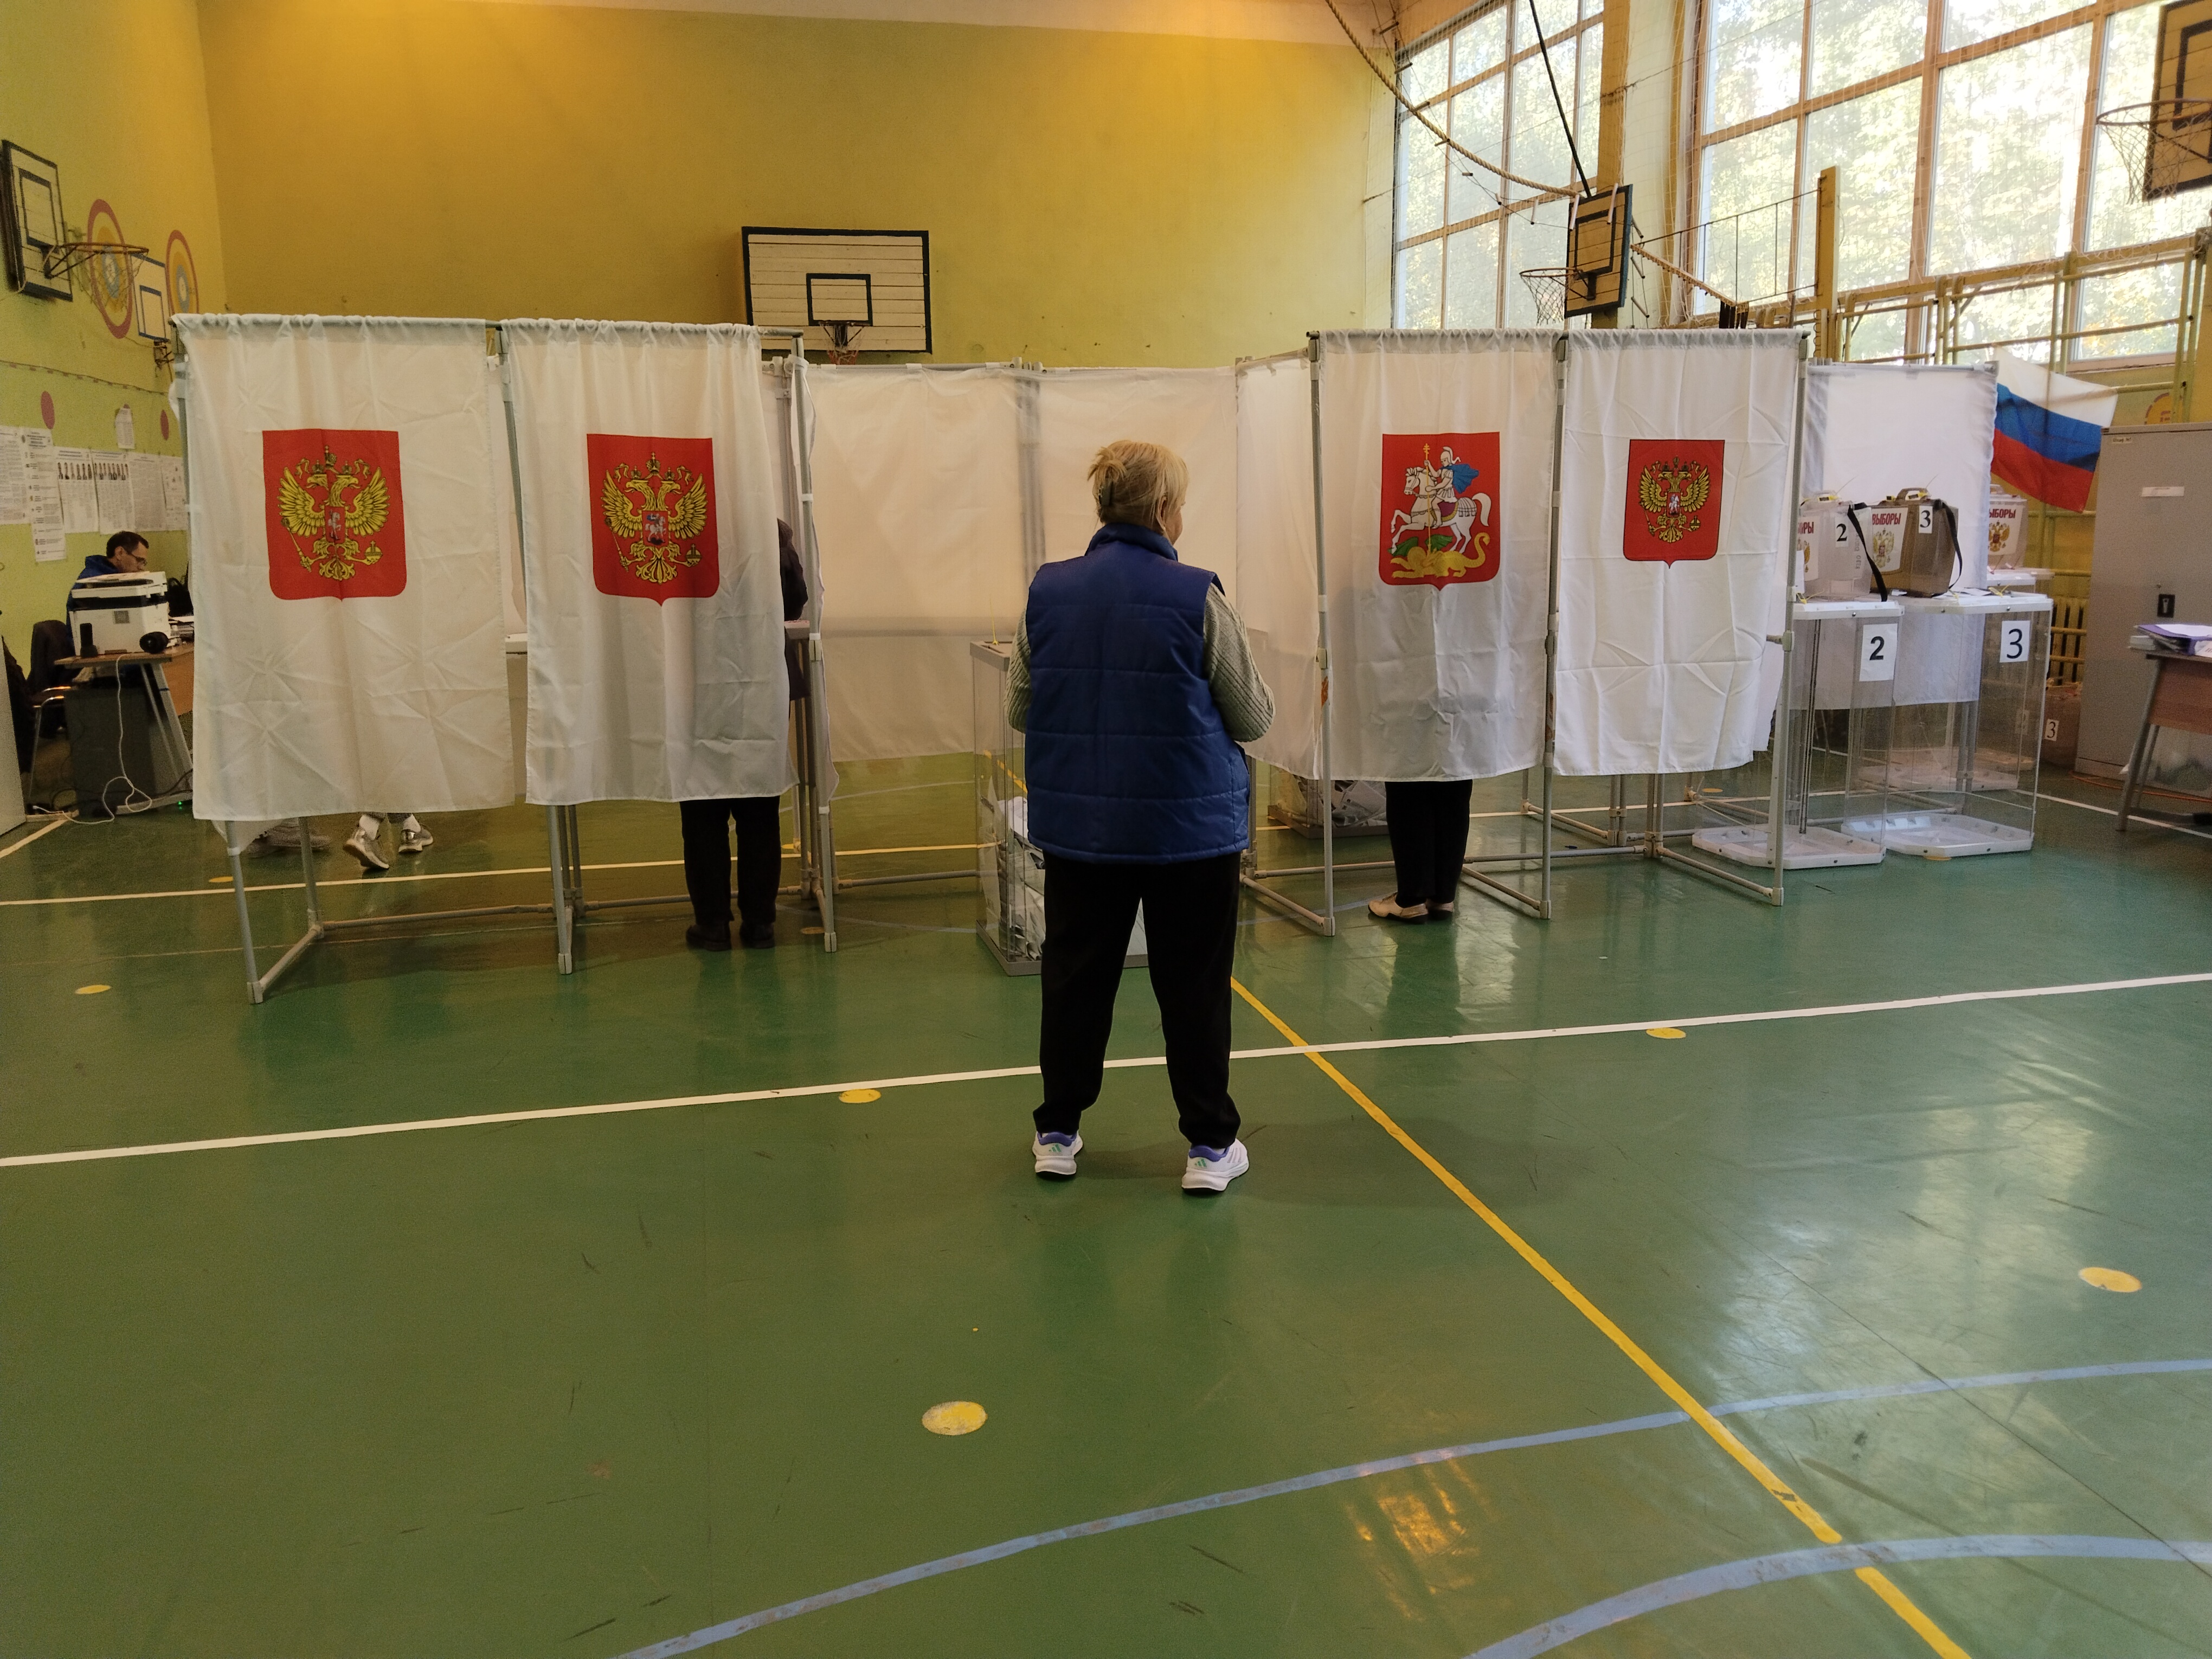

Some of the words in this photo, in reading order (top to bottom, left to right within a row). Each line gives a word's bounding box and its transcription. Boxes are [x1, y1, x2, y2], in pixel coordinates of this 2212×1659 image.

[1872, 513, 1901, 525] ВЫБОРЫ
[1920, 510, 1931, 528] 3
[1989, 509, 2016, 518] ЫБОРЫ
[1836, 523, 1848, 542] 2
[1869, 636, 1885, 660] 2
[2007, 628, 2023, 659] 3
[2047, 721, 2056, 738] 3
